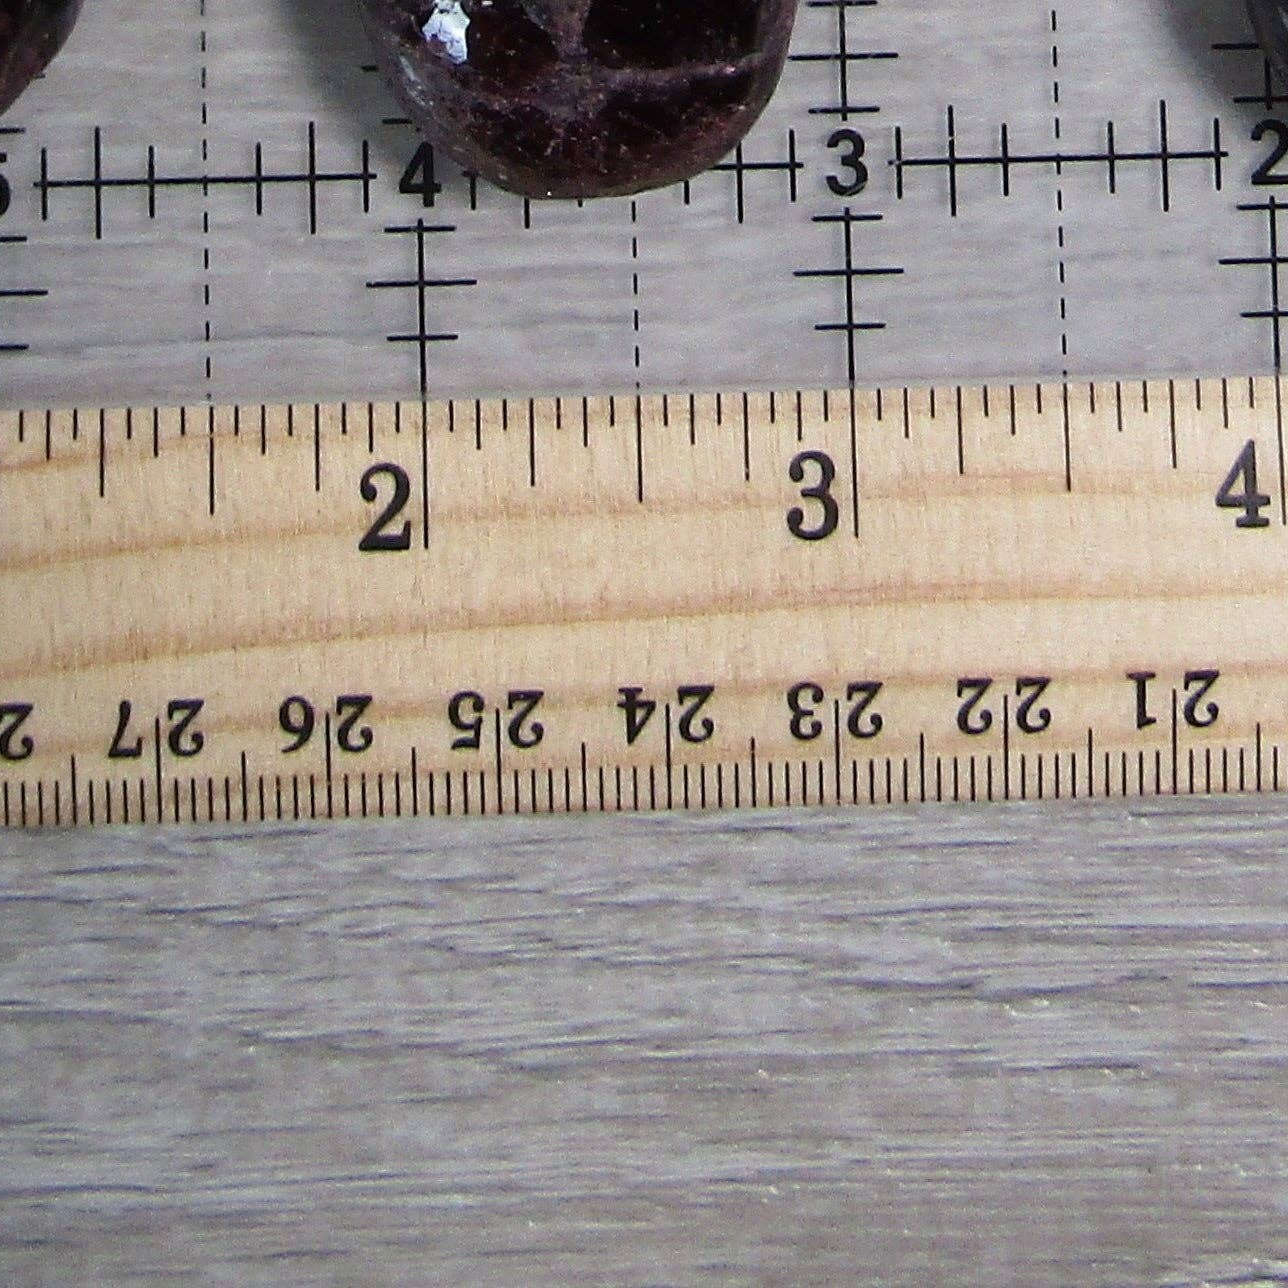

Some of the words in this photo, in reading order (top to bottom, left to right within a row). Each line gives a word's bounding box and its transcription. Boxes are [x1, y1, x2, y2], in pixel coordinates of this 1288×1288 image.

[398, 142, 441, 209] 4
[825, 128, 869, 198] 3
[358, 462, 413, 553] 2
[787, 450, 839, 541] 3
[1215, 439, 1272, 529] 4
[107, 699, 206, 759] 27
[278, 694, 375, 753] 26
[448, 689, 546, 749] 25
[617, 684, 716, 744] 24
[787, 680, 884, 740] 23
[955, 677, 1052, 736] 22
[1127, 670, 1220, 729] 21
